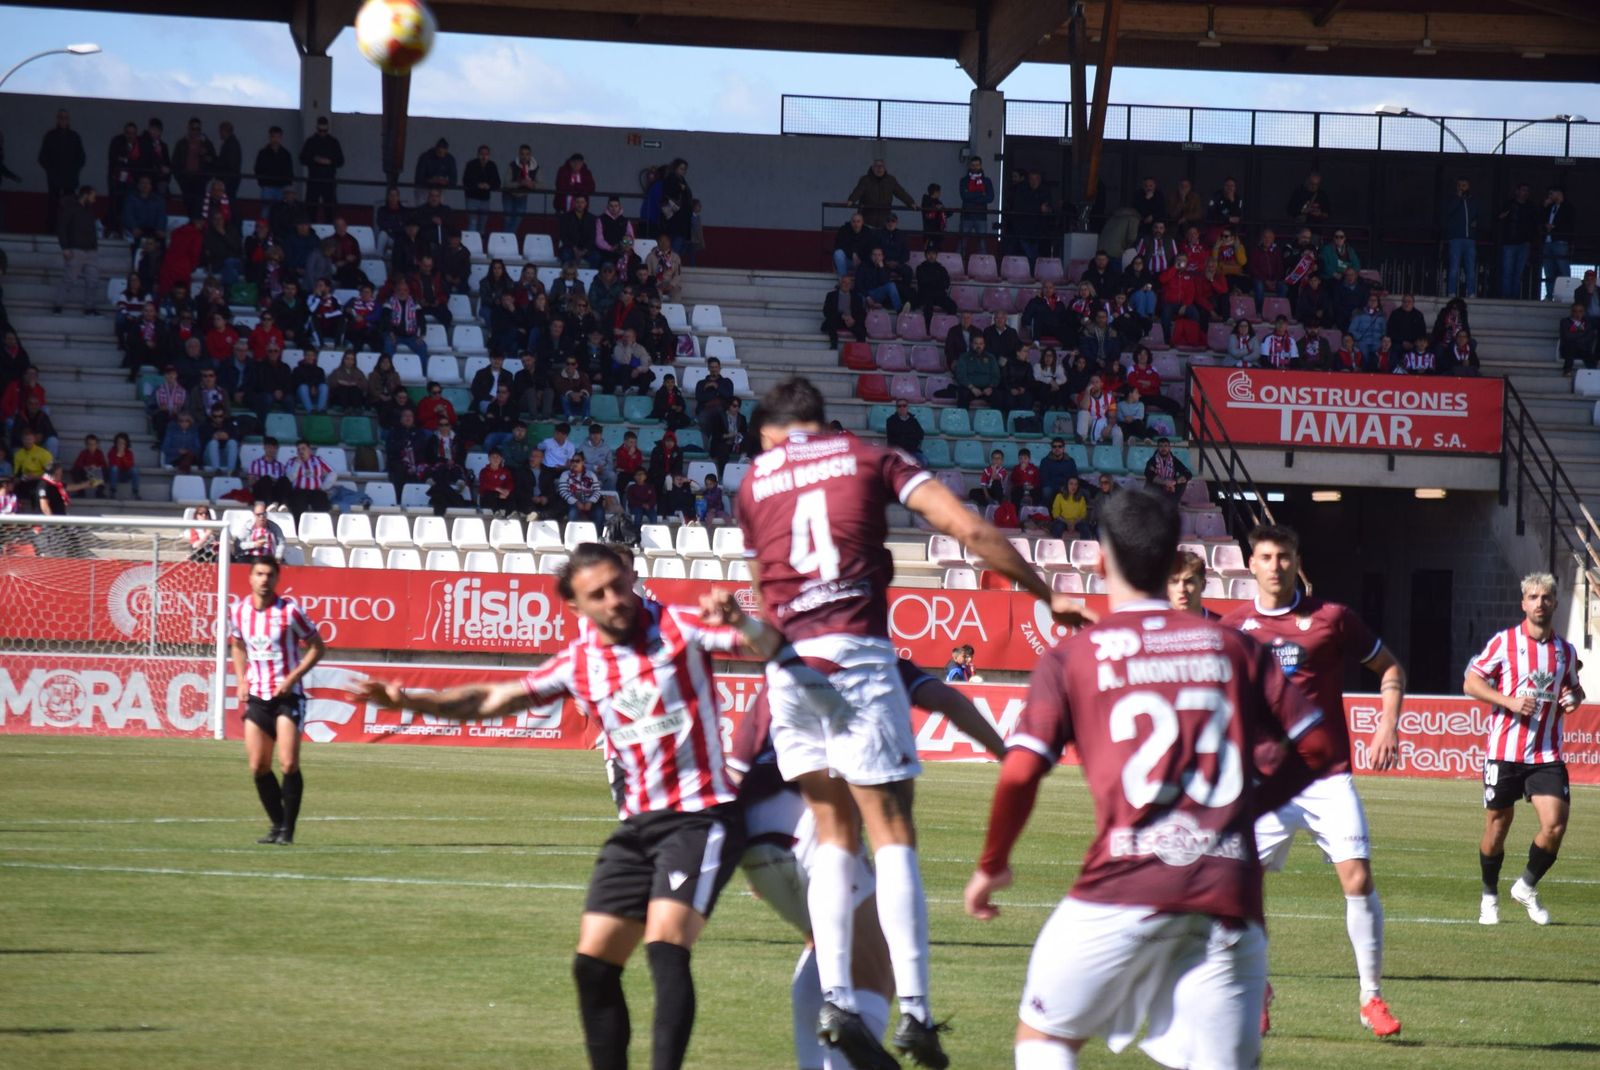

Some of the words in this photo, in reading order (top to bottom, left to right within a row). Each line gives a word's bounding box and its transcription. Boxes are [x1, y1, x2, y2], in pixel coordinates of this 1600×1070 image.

[1226, 370, 1469, 411] CONSTRUCCIONES
[1279, 406, 1422, 448] TAMAR,
[1433, 432, 1467, 448] S.A.
[789, 488, 840, 582] 4
[453, 577, 551, 622] fisio
[887, 593, 988, 643] ORA
[453, 613, 565, 648] readapt
[1126, 654, 1233, 686] MONTORO
[1350, 706, 1490, 737] Ecuel
[1109, 687, 1244, 810] 23
